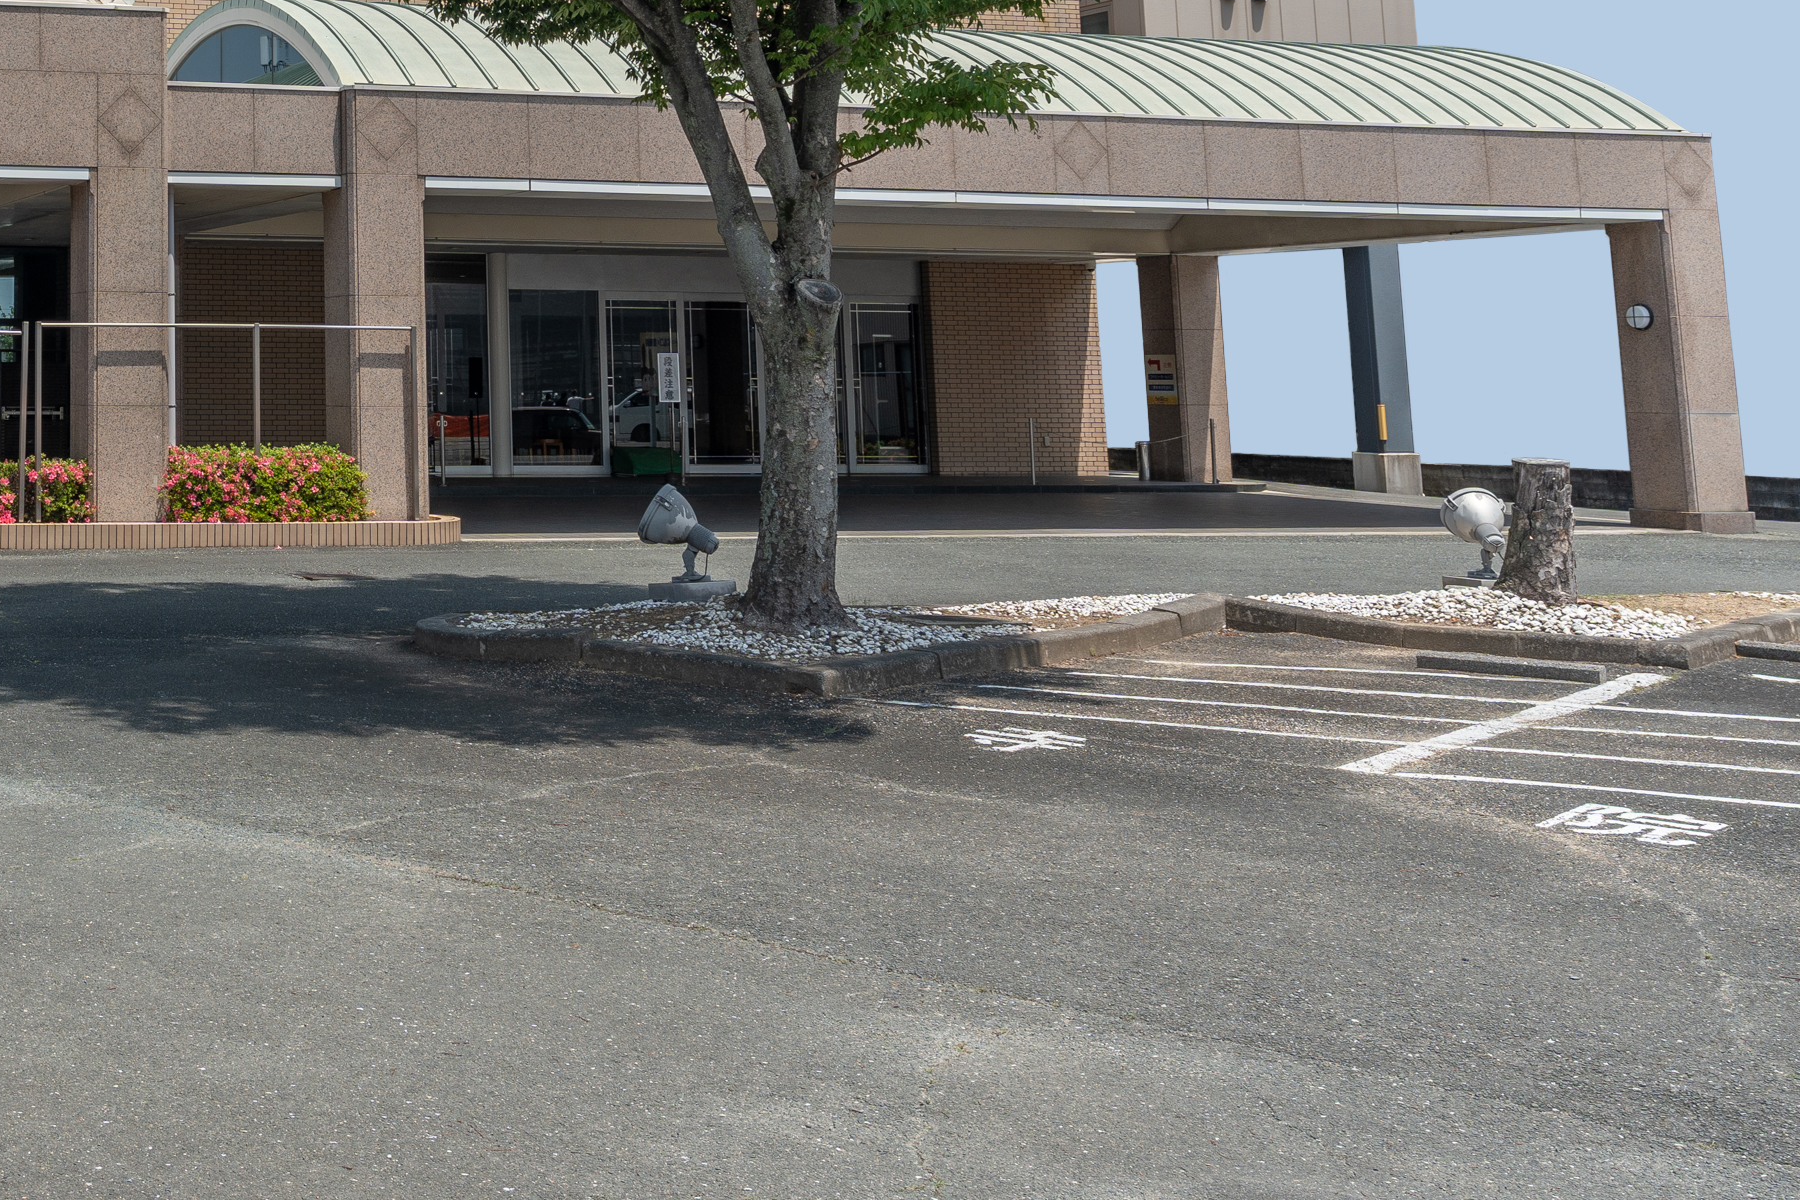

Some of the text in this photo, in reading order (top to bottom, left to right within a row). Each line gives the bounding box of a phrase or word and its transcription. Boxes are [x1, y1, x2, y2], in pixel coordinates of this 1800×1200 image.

[663, 356, 674, 400] 段差注意
[1535, 803, 1729, 846] 院
